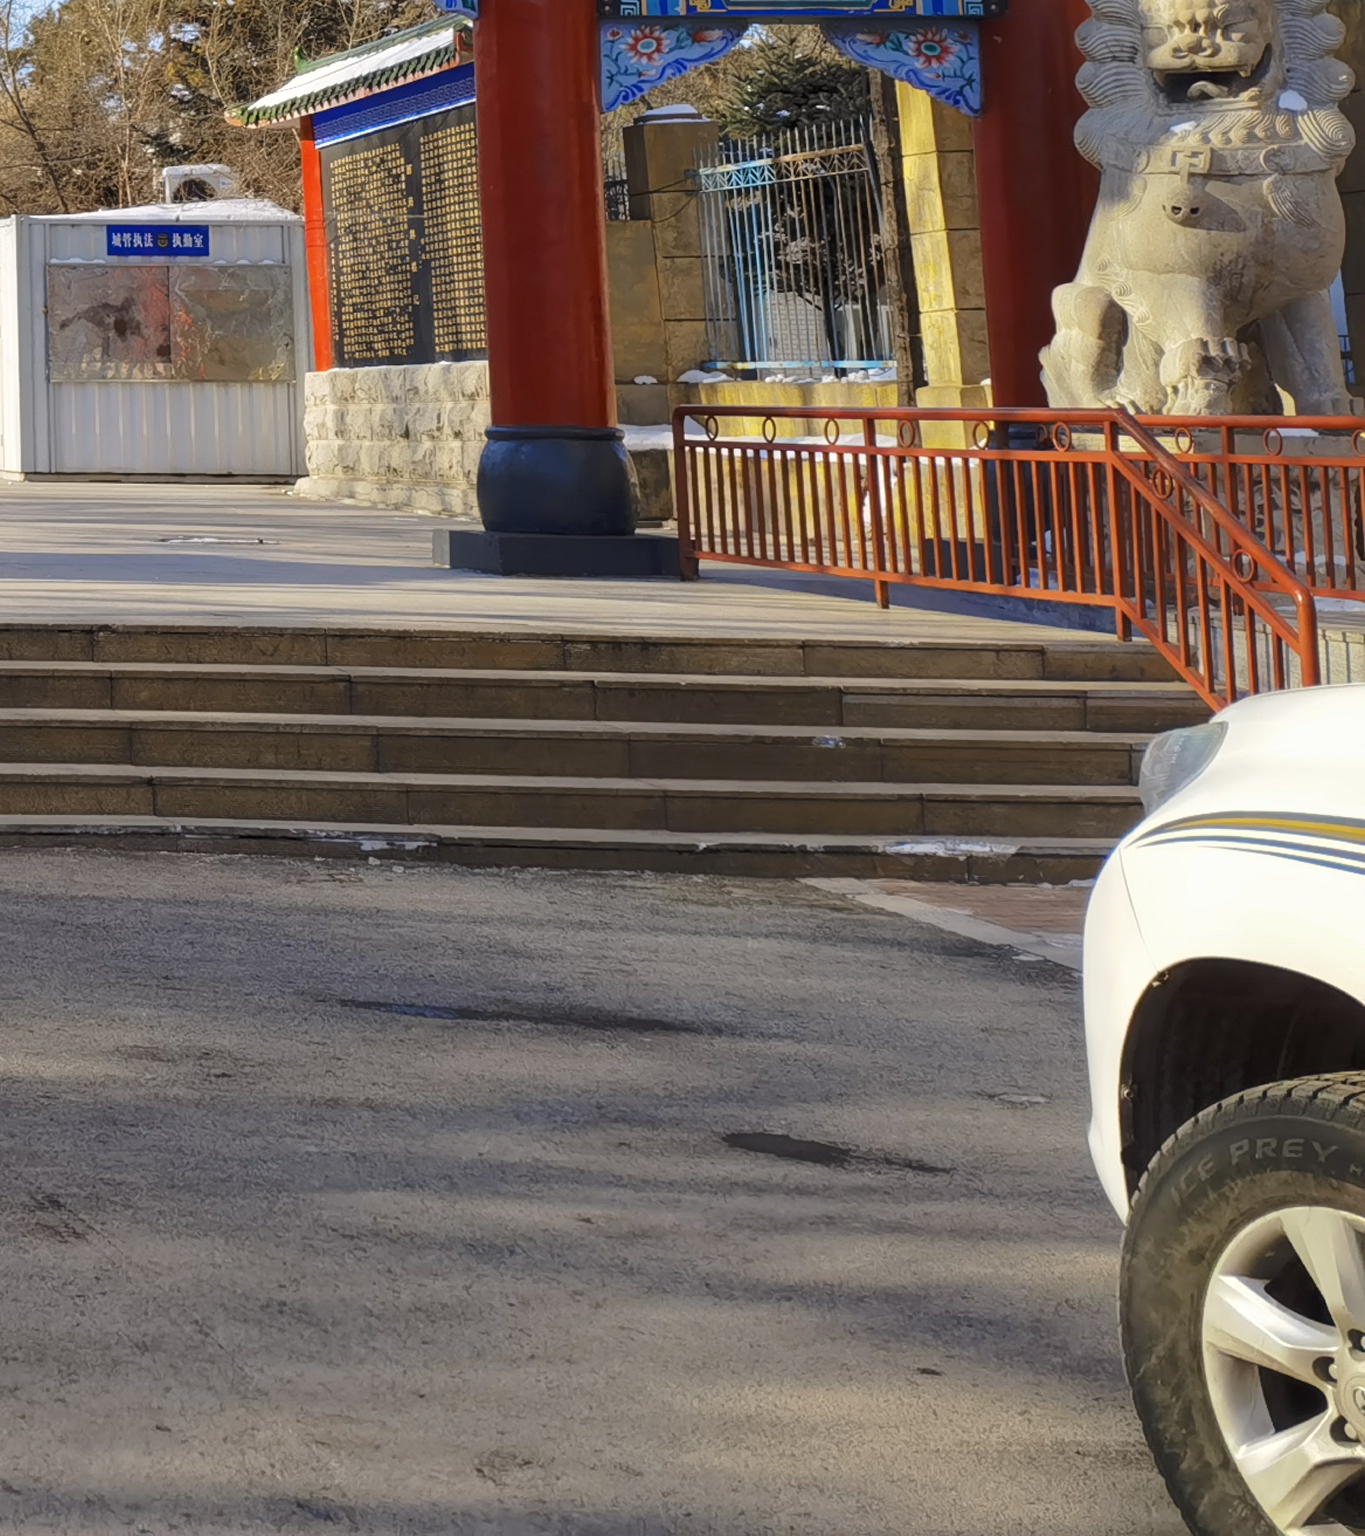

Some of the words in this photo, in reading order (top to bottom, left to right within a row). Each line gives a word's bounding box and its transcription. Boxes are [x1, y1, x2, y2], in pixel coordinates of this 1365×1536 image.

[111, 232, 154, 248] 城管执法
[172, 232, 204, 248] 执勤室
[1171, 1151, 1217, 1207] ICE
[1229, 1137, 1338, 1166] PREY
